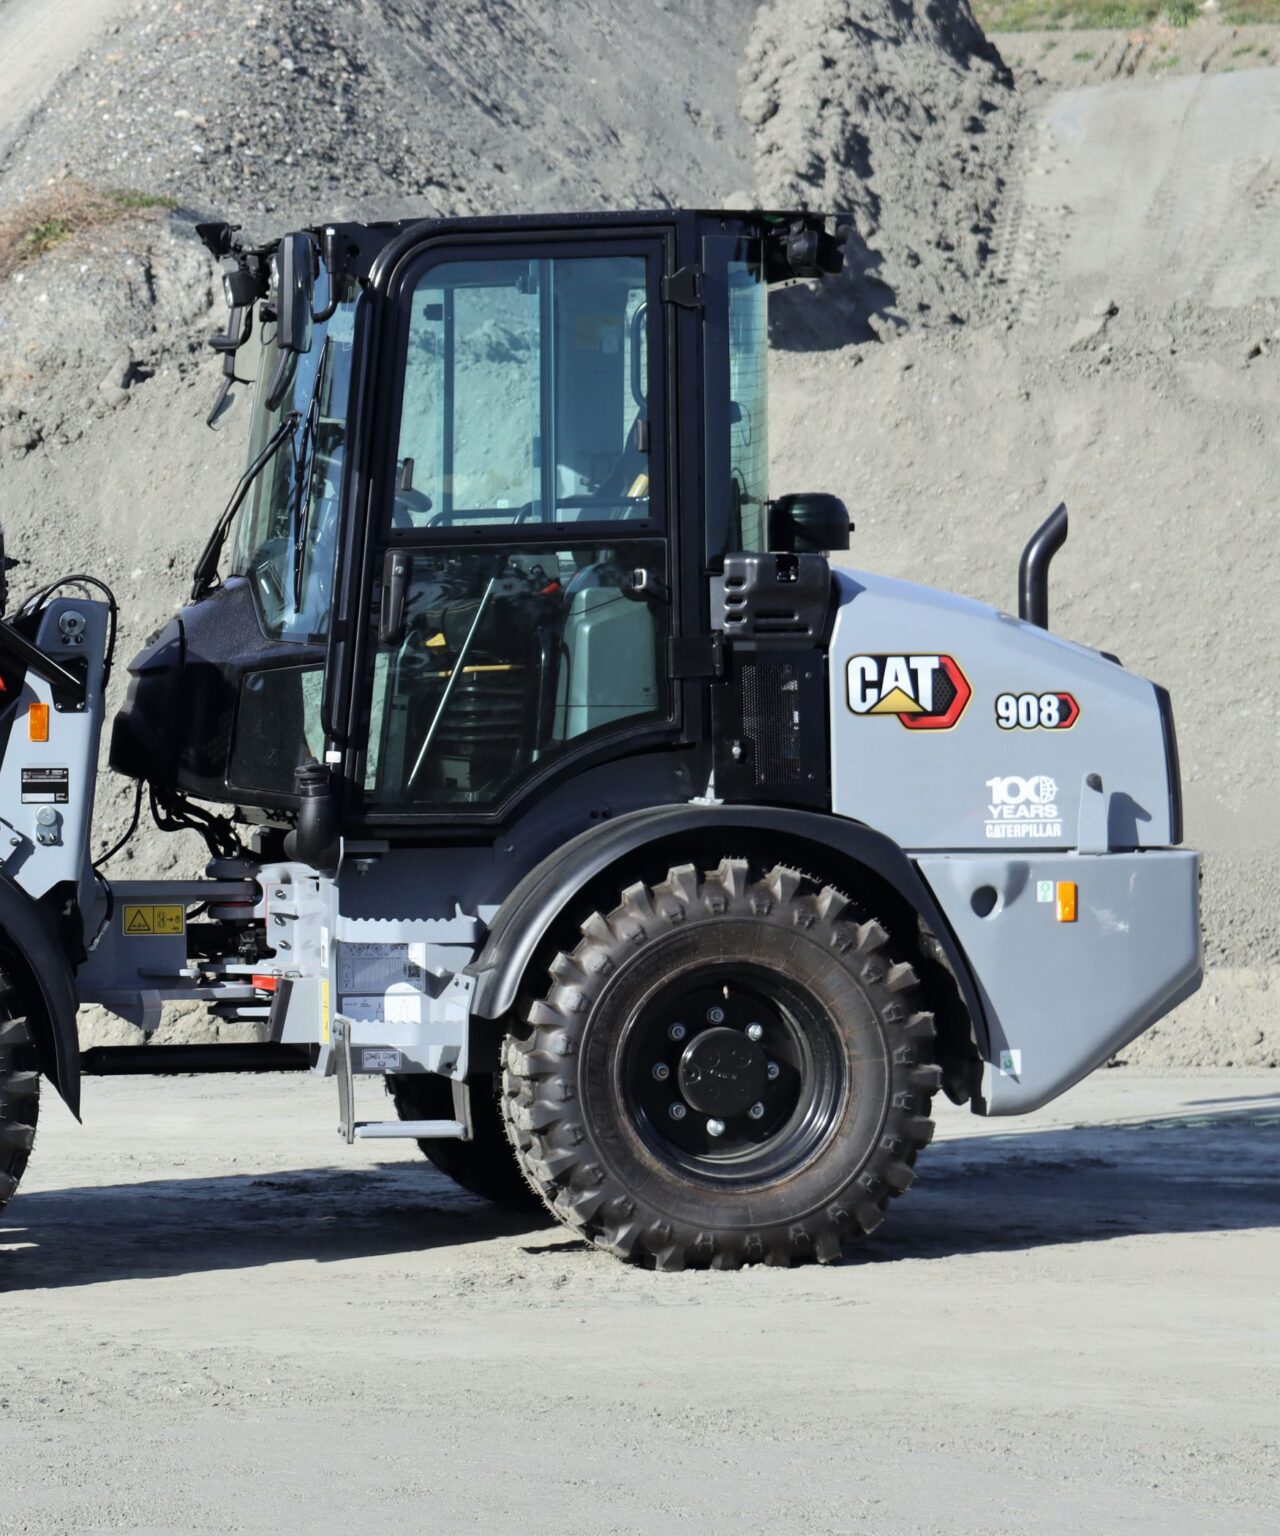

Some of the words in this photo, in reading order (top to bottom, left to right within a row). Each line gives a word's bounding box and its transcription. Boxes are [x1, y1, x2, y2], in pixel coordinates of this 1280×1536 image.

[847, 655, 940, 714] CAT
[996, 694, 1060, 729] 908
[985, 775, 1059, 804] 100
[988, 804, 1058, 819] YEARS
[985, 823, 1062, 839] CATERPILLAR
